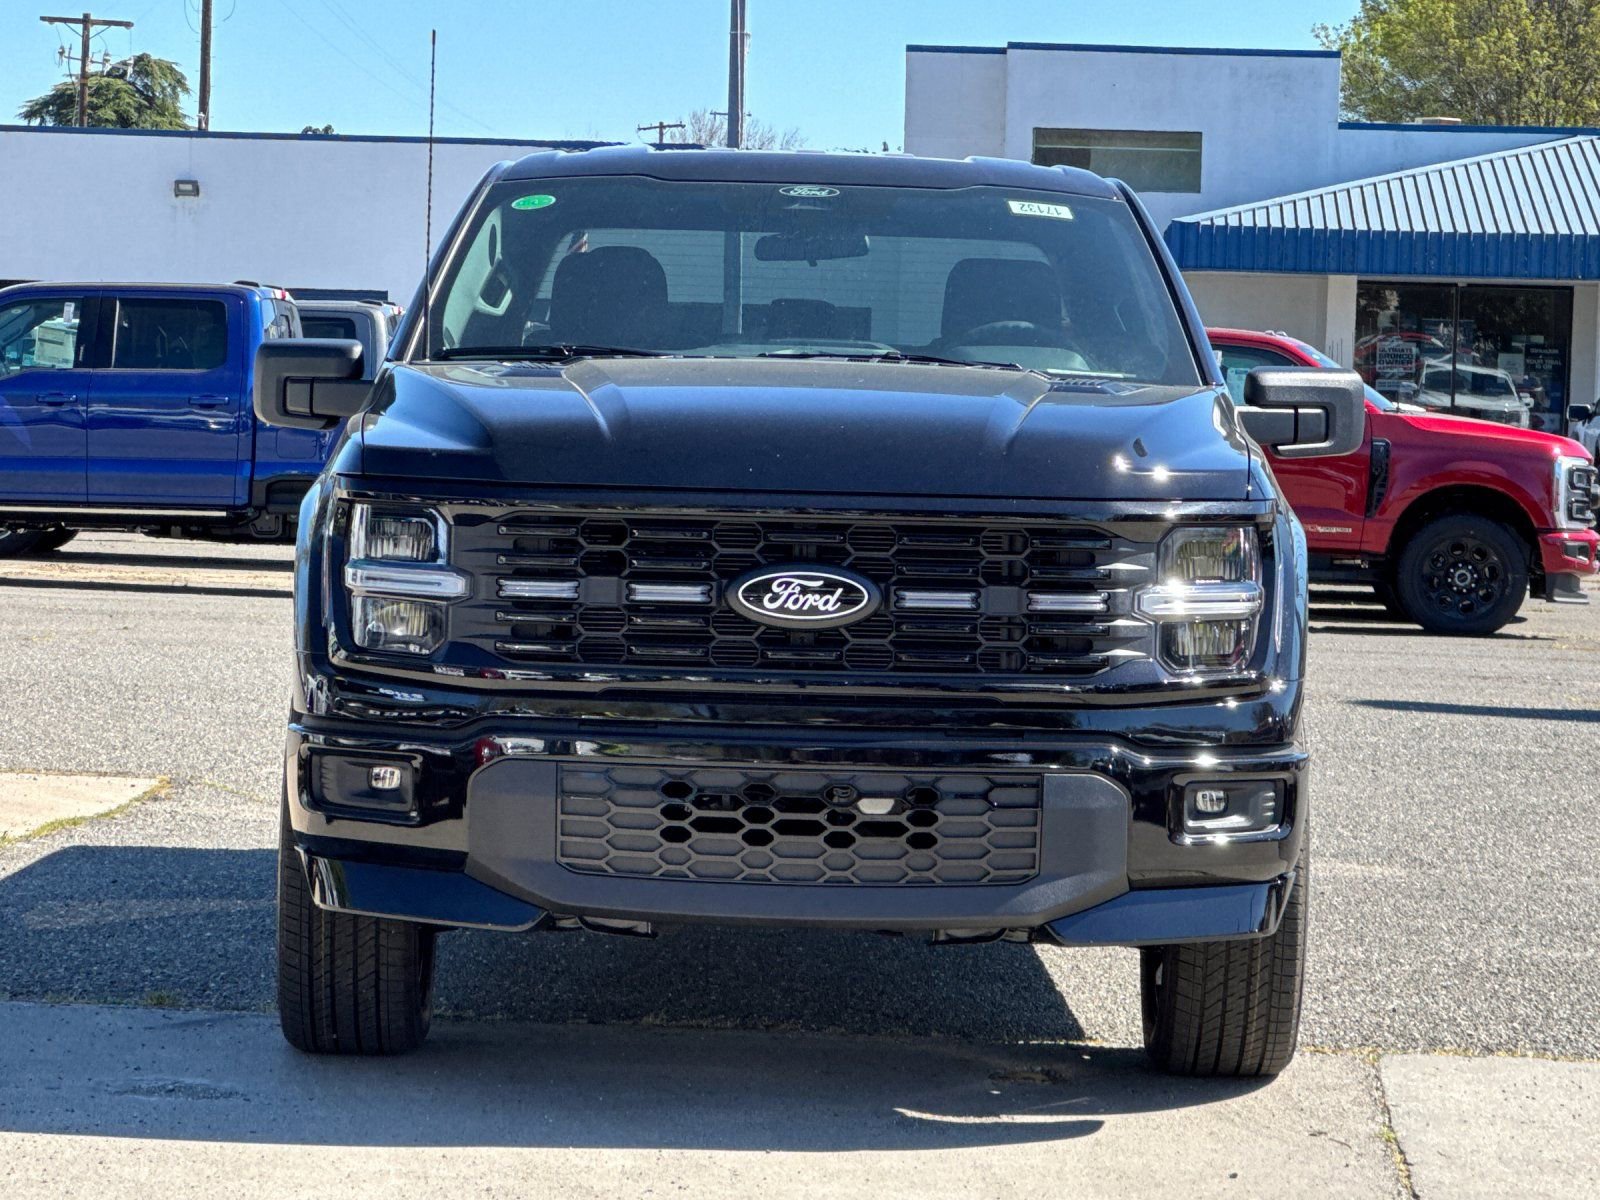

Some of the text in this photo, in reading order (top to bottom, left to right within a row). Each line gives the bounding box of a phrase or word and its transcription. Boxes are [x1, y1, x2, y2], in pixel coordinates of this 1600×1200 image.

[790, 186, 829, 196] Ford
[1019, 203, 1061, 216] 17132
[763, 577, 843, 611] Ford
